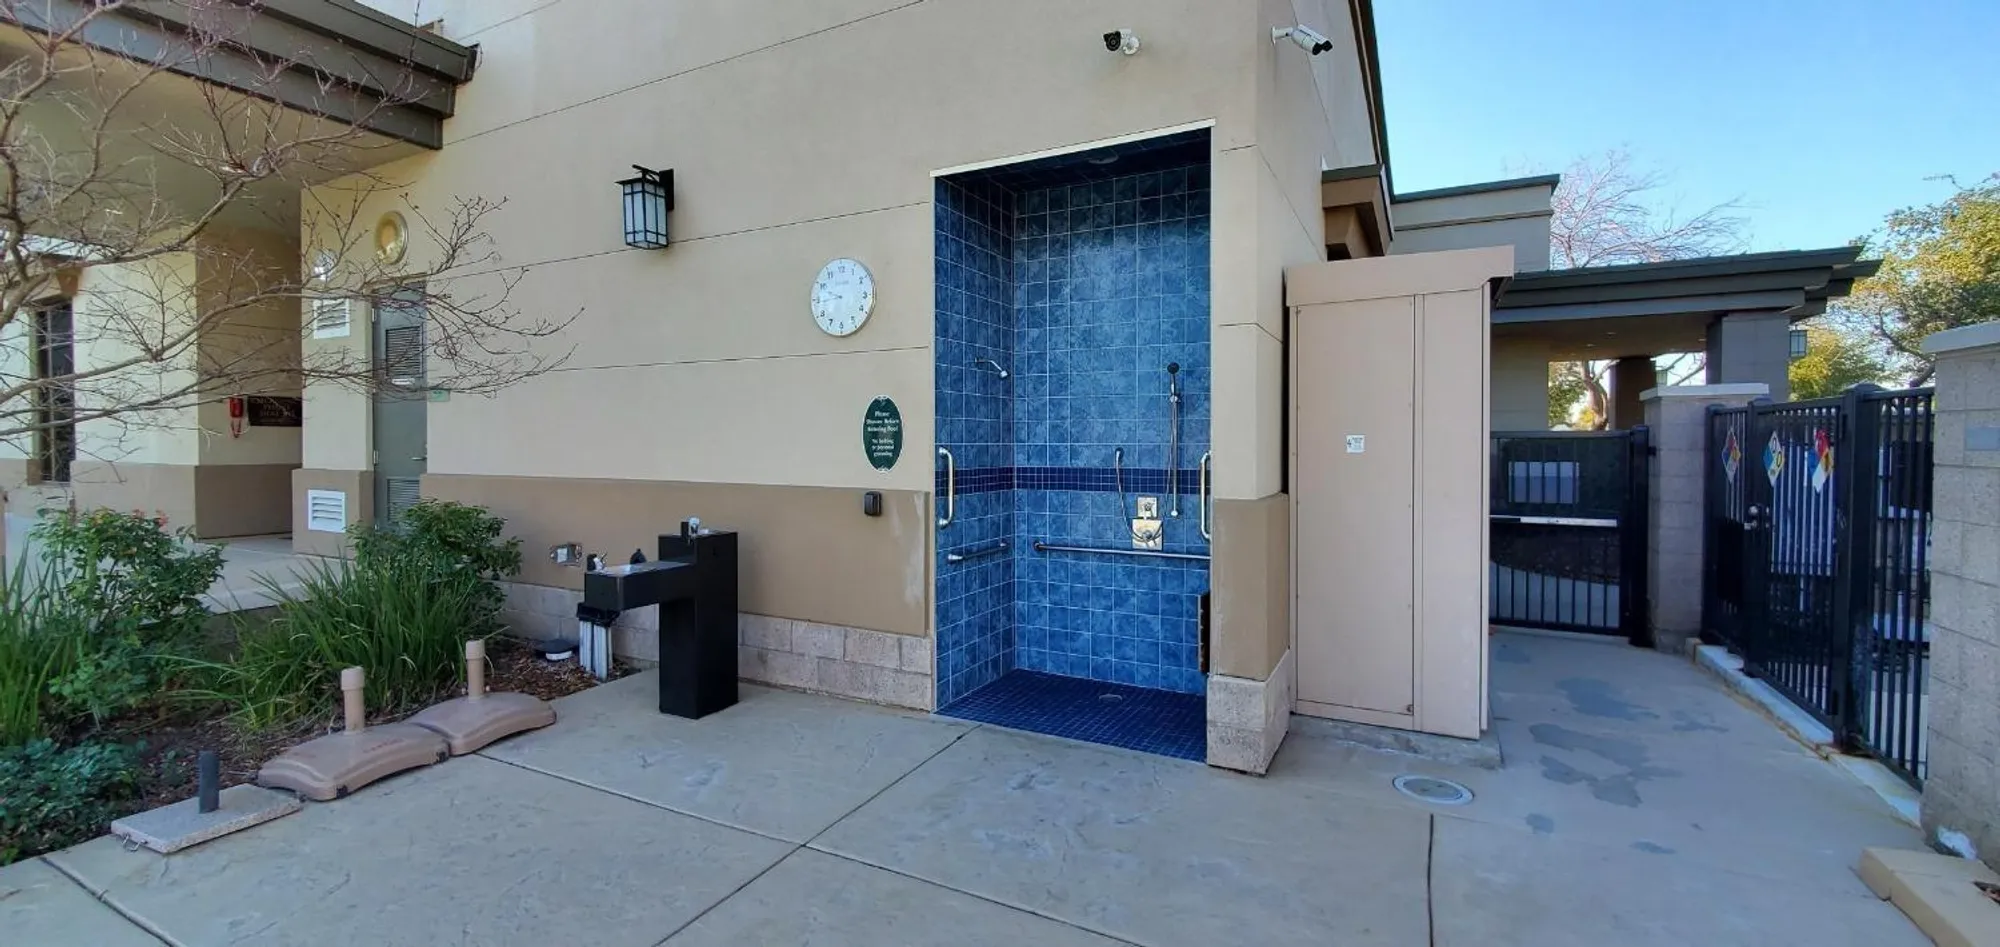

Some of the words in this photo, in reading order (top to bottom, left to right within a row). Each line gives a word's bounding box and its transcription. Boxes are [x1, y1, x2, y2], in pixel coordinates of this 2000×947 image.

[827, 271, 834, 279] 11
[820, 282, 827, 290] 10
[828, 318, 833, 327] 7
